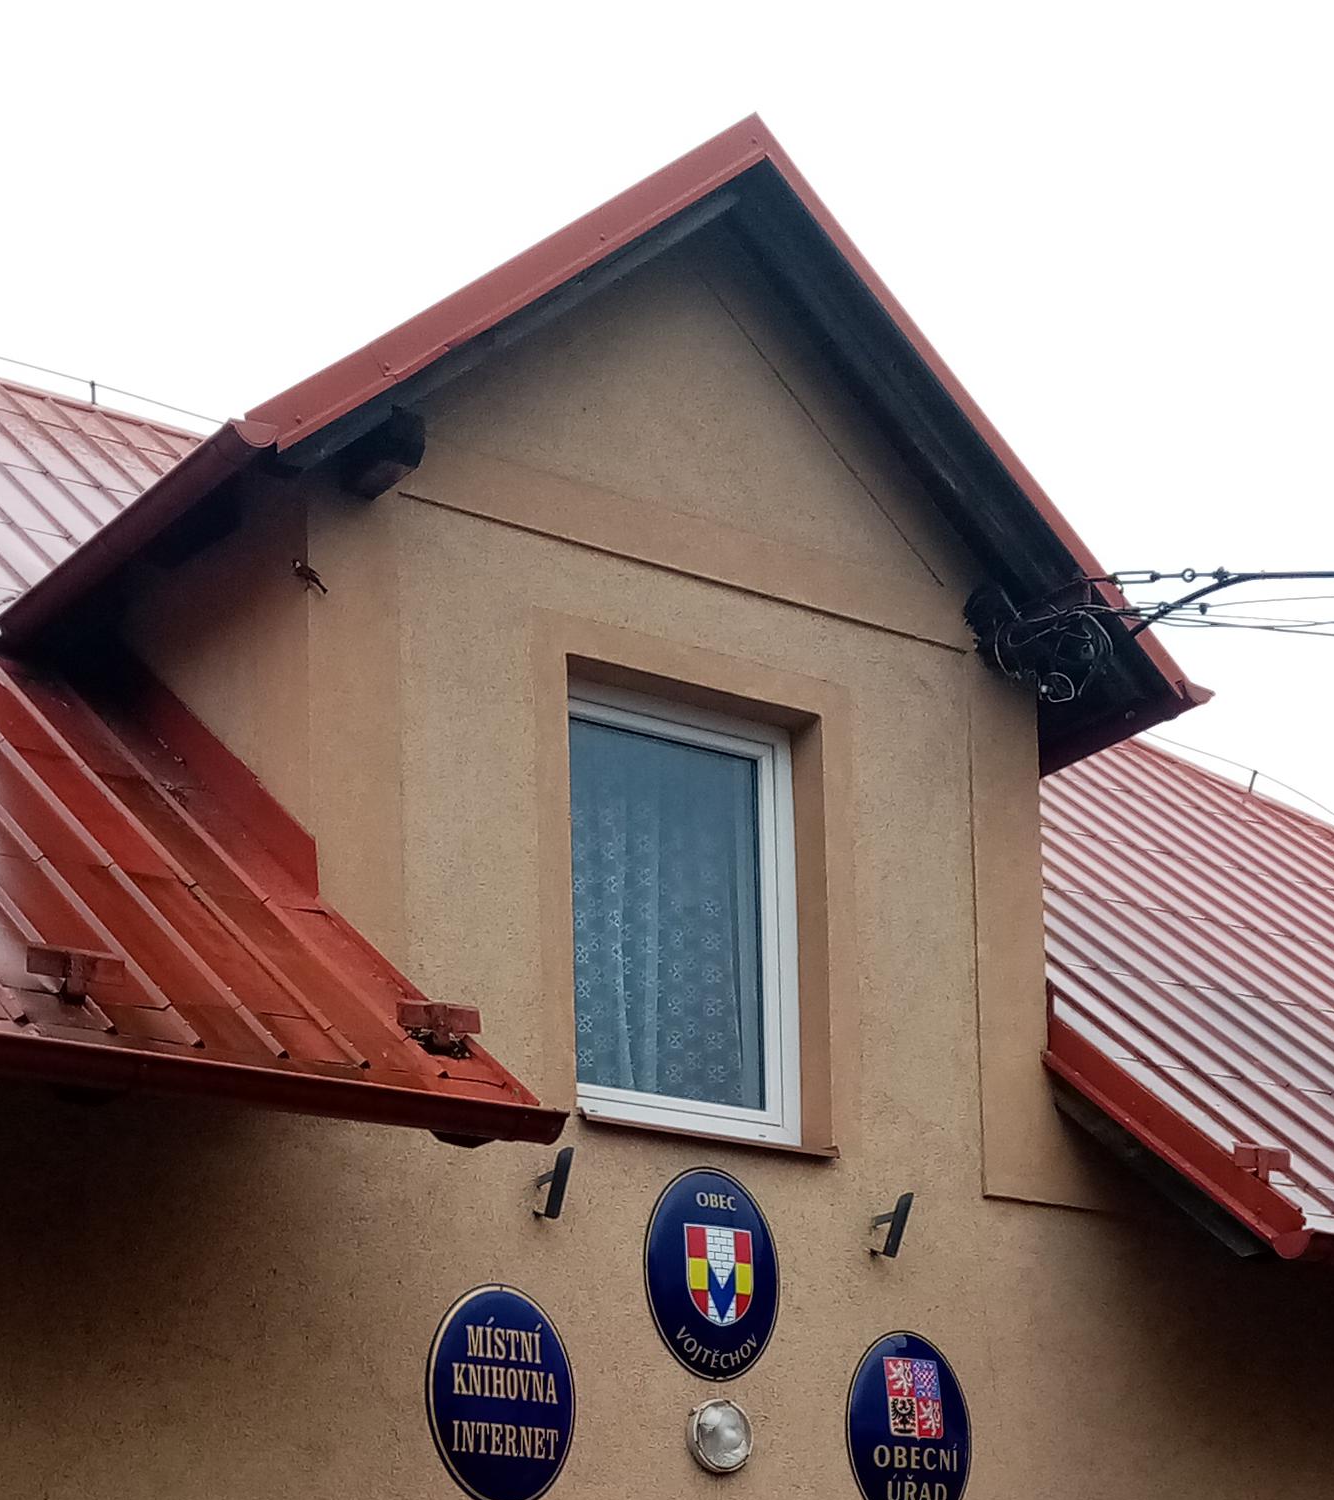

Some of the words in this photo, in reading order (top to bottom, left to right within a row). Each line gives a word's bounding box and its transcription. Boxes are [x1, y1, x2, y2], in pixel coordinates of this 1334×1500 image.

[696, 1192, 737, 1211] OBEC
[466, 1316, 542, 1364] MÍSTNÍ
[676, 1326, 758, 1369] VOJTĚCHOV
[452, 1363, 558, 1404] KNIHOVNA
[452, 1420, 559, 1460] INTERNET
[873, 1443, 958, 1472] OBECNÍ
